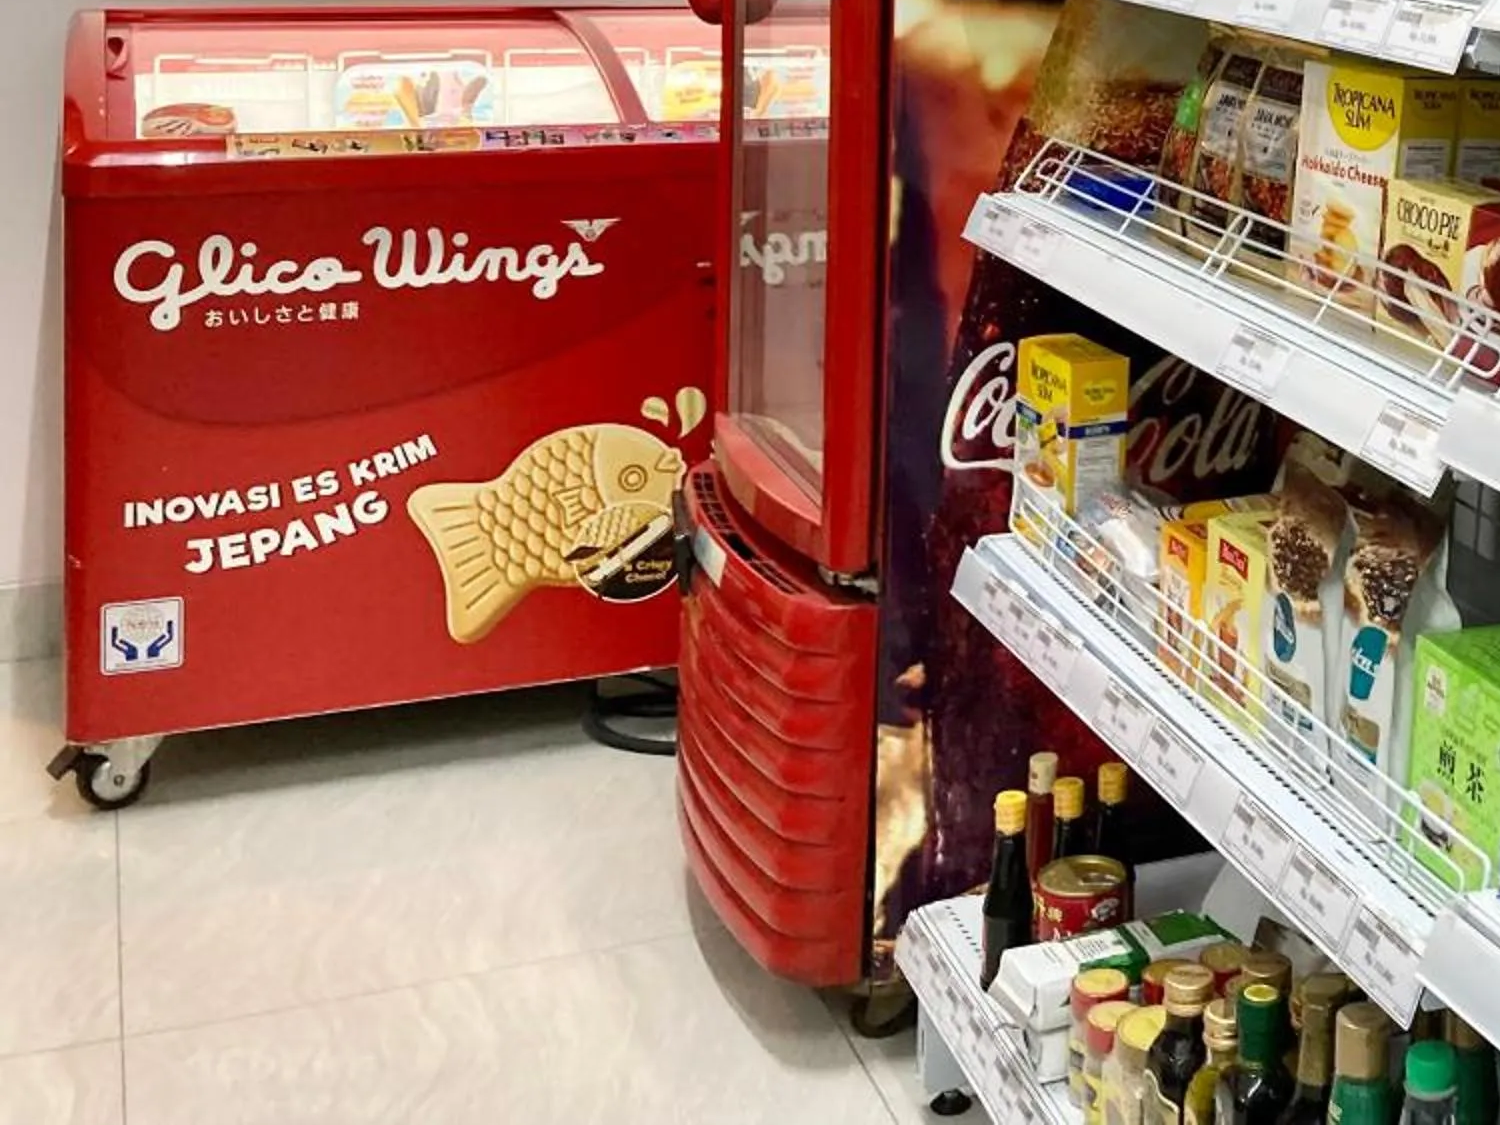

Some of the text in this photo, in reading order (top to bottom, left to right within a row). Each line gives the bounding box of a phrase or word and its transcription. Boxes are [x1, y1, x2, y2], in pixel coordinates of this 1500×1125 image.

[1332, 82, 1396, 120] TROPICANA
[1343, 110, 1372, 132] SLIM
[1301, 154, 1346, 180] Hokkaido
[1396, 195, 1439, 235] CHOCO
[114, 225, 605, 332] Glico Wings
[204, 301, 360, 329] おいしさと健康
[123, 434, 438, 529] INOVASI ES KRIM
[184, 491, 390, 575] JEPANG
